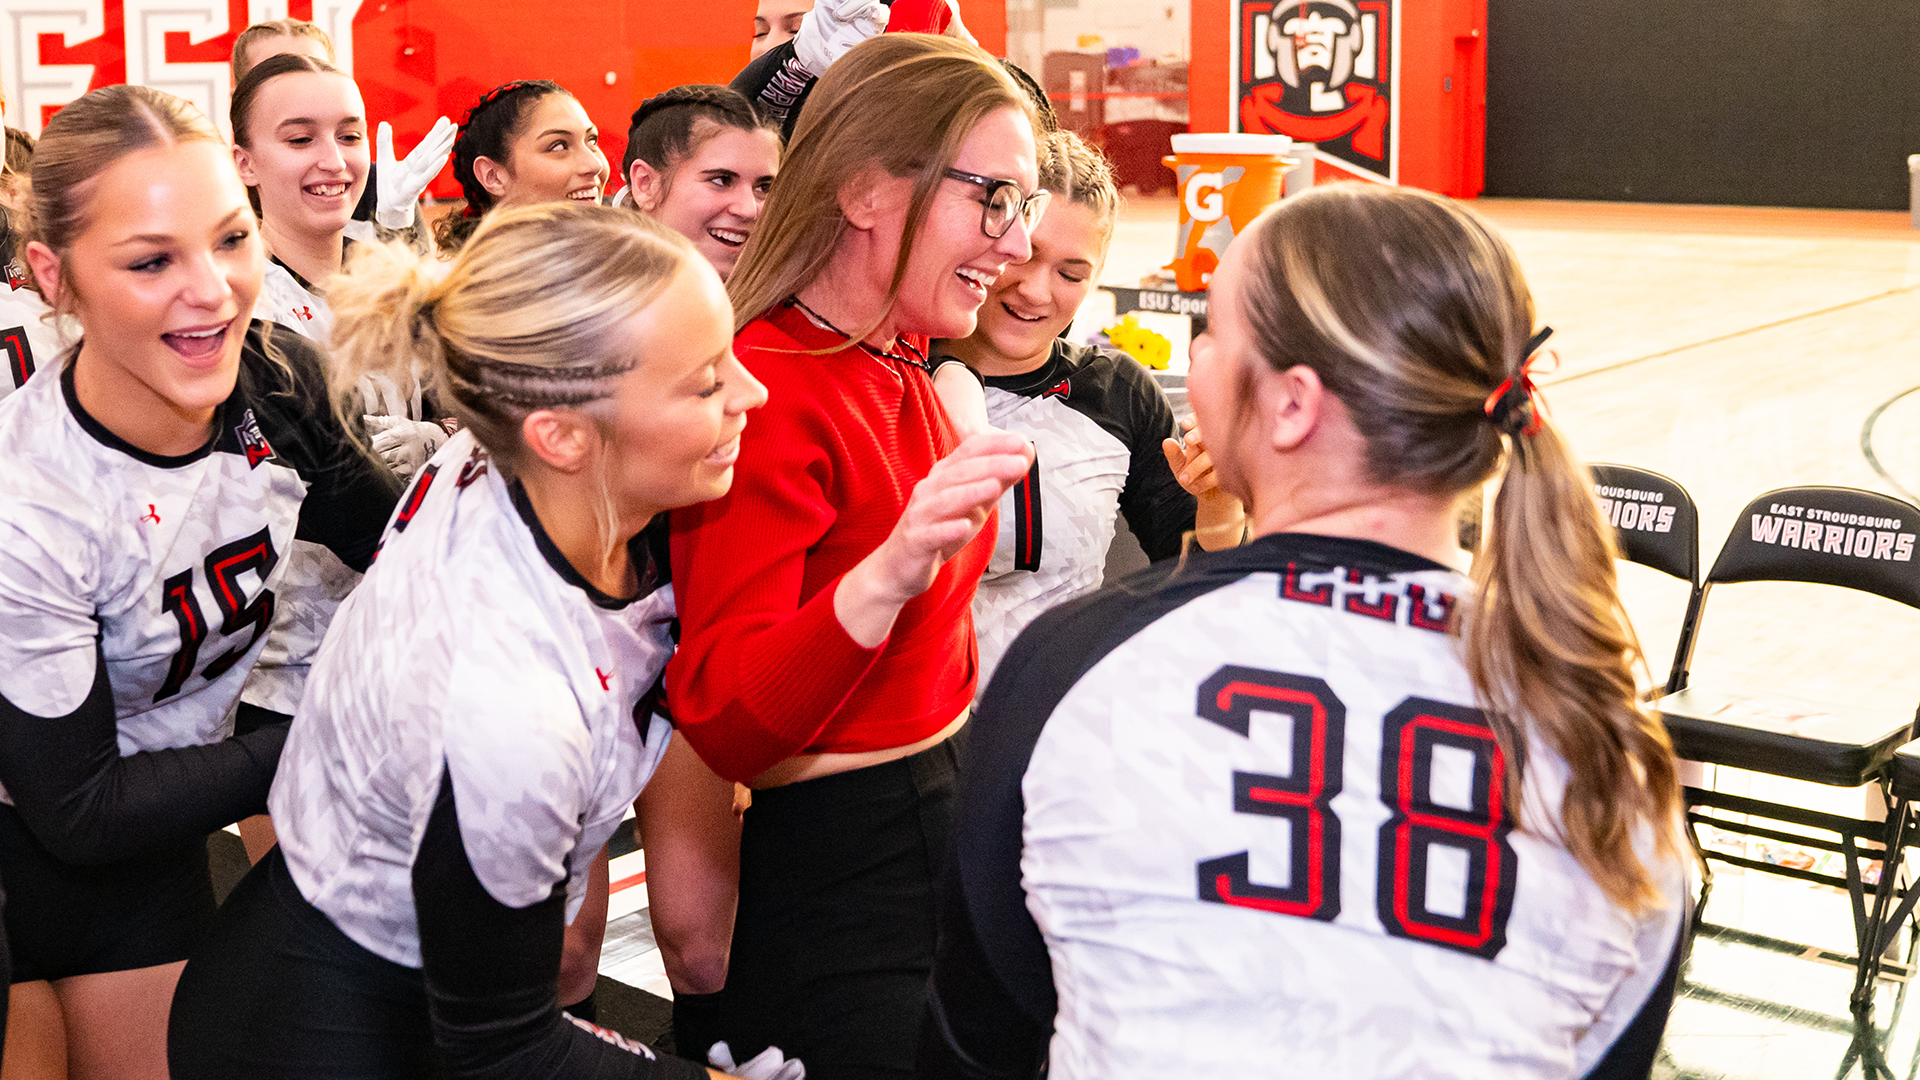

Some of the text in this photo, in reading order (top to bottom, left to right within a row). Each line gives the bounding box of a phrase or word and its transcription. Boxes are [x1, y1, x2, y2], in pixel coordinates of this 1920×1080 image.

[1185, 172, 1223, 222] G
[1139, 291, 1169, 310] ESU
[1751, 513, 1917, 562] WARRIORS
[1770, 503, 1902, 530] EAST STROUDSBURG
[152, 524, 279, 704] 15
[1195, 664, 1525, 962] 38
